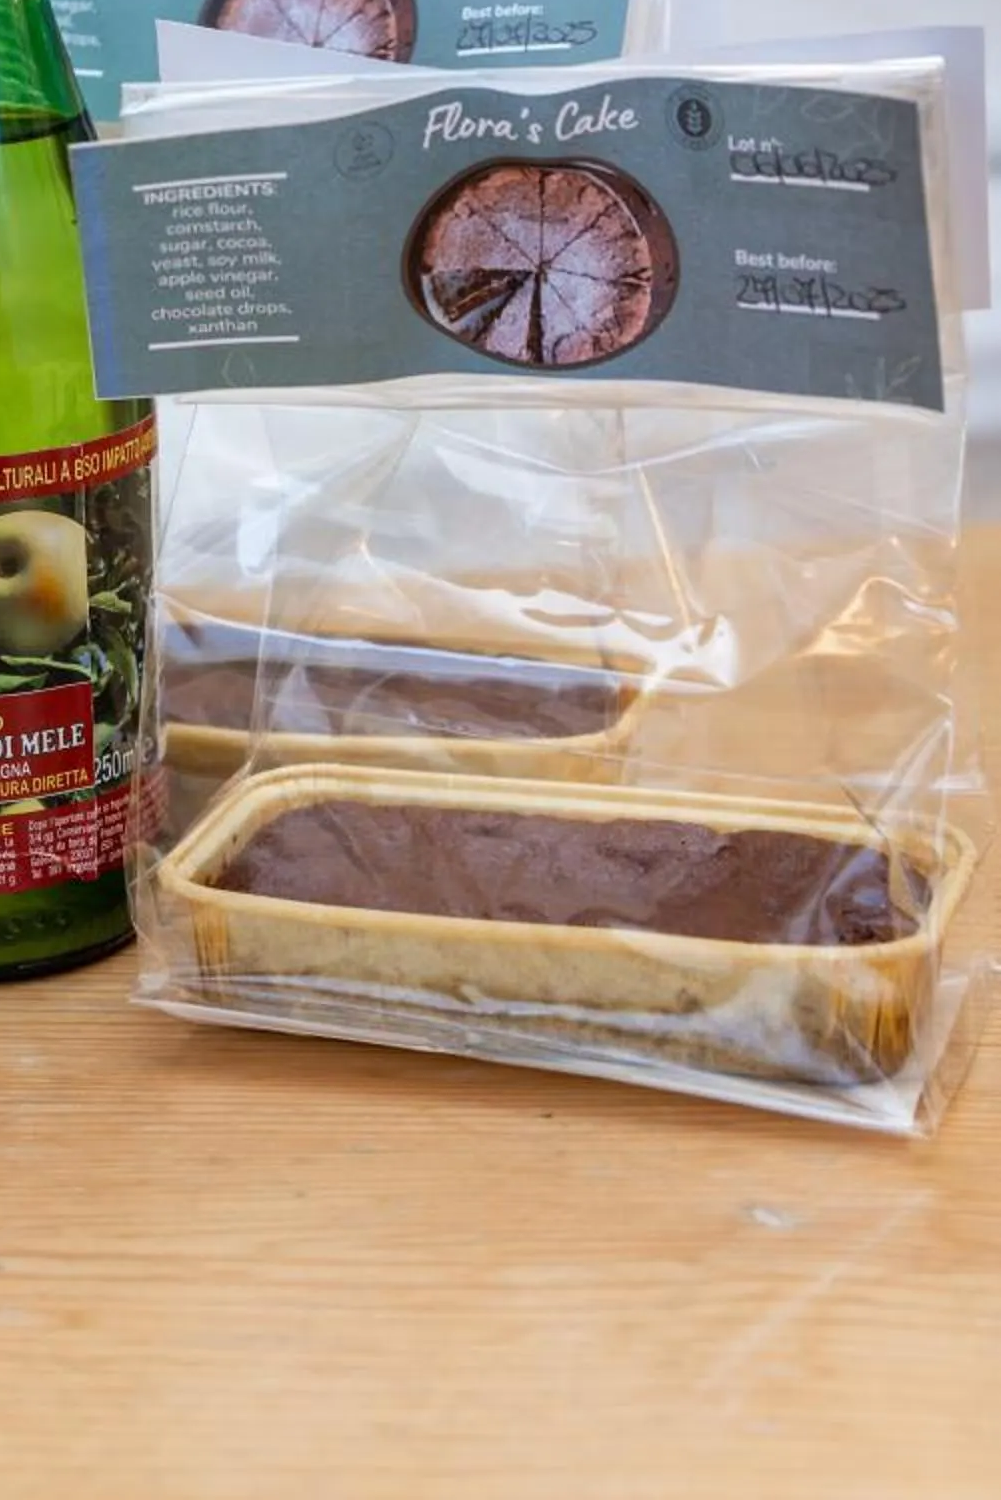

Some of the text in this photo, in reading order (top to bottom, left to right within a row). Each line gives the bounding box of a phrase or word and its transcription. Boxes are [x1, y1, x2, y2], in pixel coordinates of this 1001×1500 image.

[461, 6, 492, 20] Best
[422, 95, 640, 149] Flora's Cake
[727, 134, 756, 152] Lot
[172, 201, 254, 219] rice flour,
[165, 219, 263, 236] cornstarch,
[159, 236, 273, 255] sugar, cocoa,
[151, 251, 282, 273] yeast, soy milk,
[735, 250, 838, 274] Best before:
[158, 269, 280, 288] apple vinegar,
[185, 285, 256, 301] seed oil,
[151, 301, 293, 321] chocolate drops,
[188, 319, 259, 334] xanthan
[60, 460, 71, 482] A
[21, 722, 86, 756] MELE
[32, 767, 89, 793] DIRETTA
